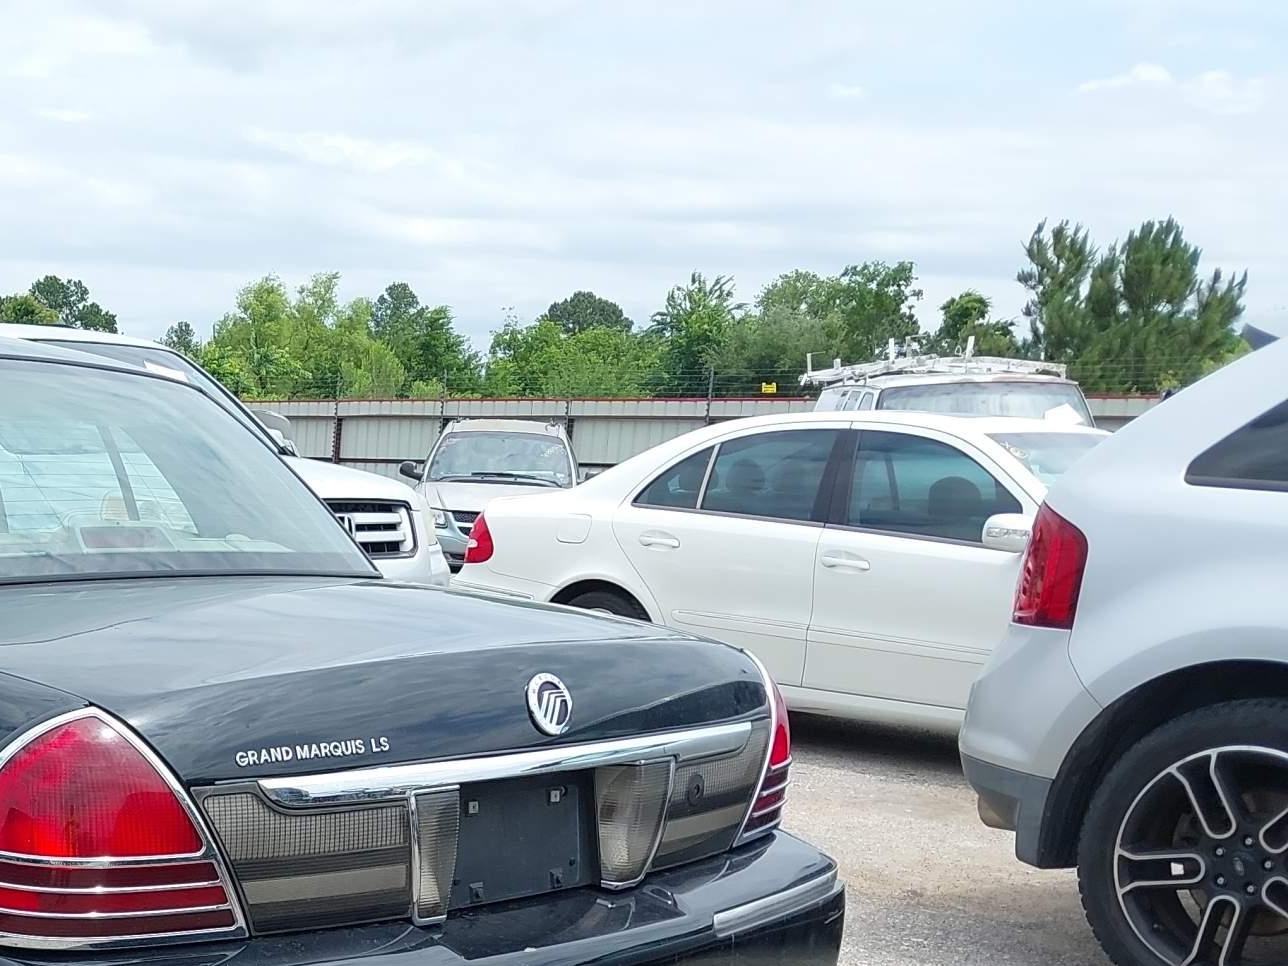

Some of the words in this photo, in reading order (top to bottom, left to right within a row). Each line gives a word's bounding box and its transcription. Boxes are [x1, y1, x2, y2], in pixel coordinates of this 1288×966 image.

[235, 746, 293, 767] GRAND
[295, 739, 365, 760] MARQUIS
[370, 737, 390, 753] LS
